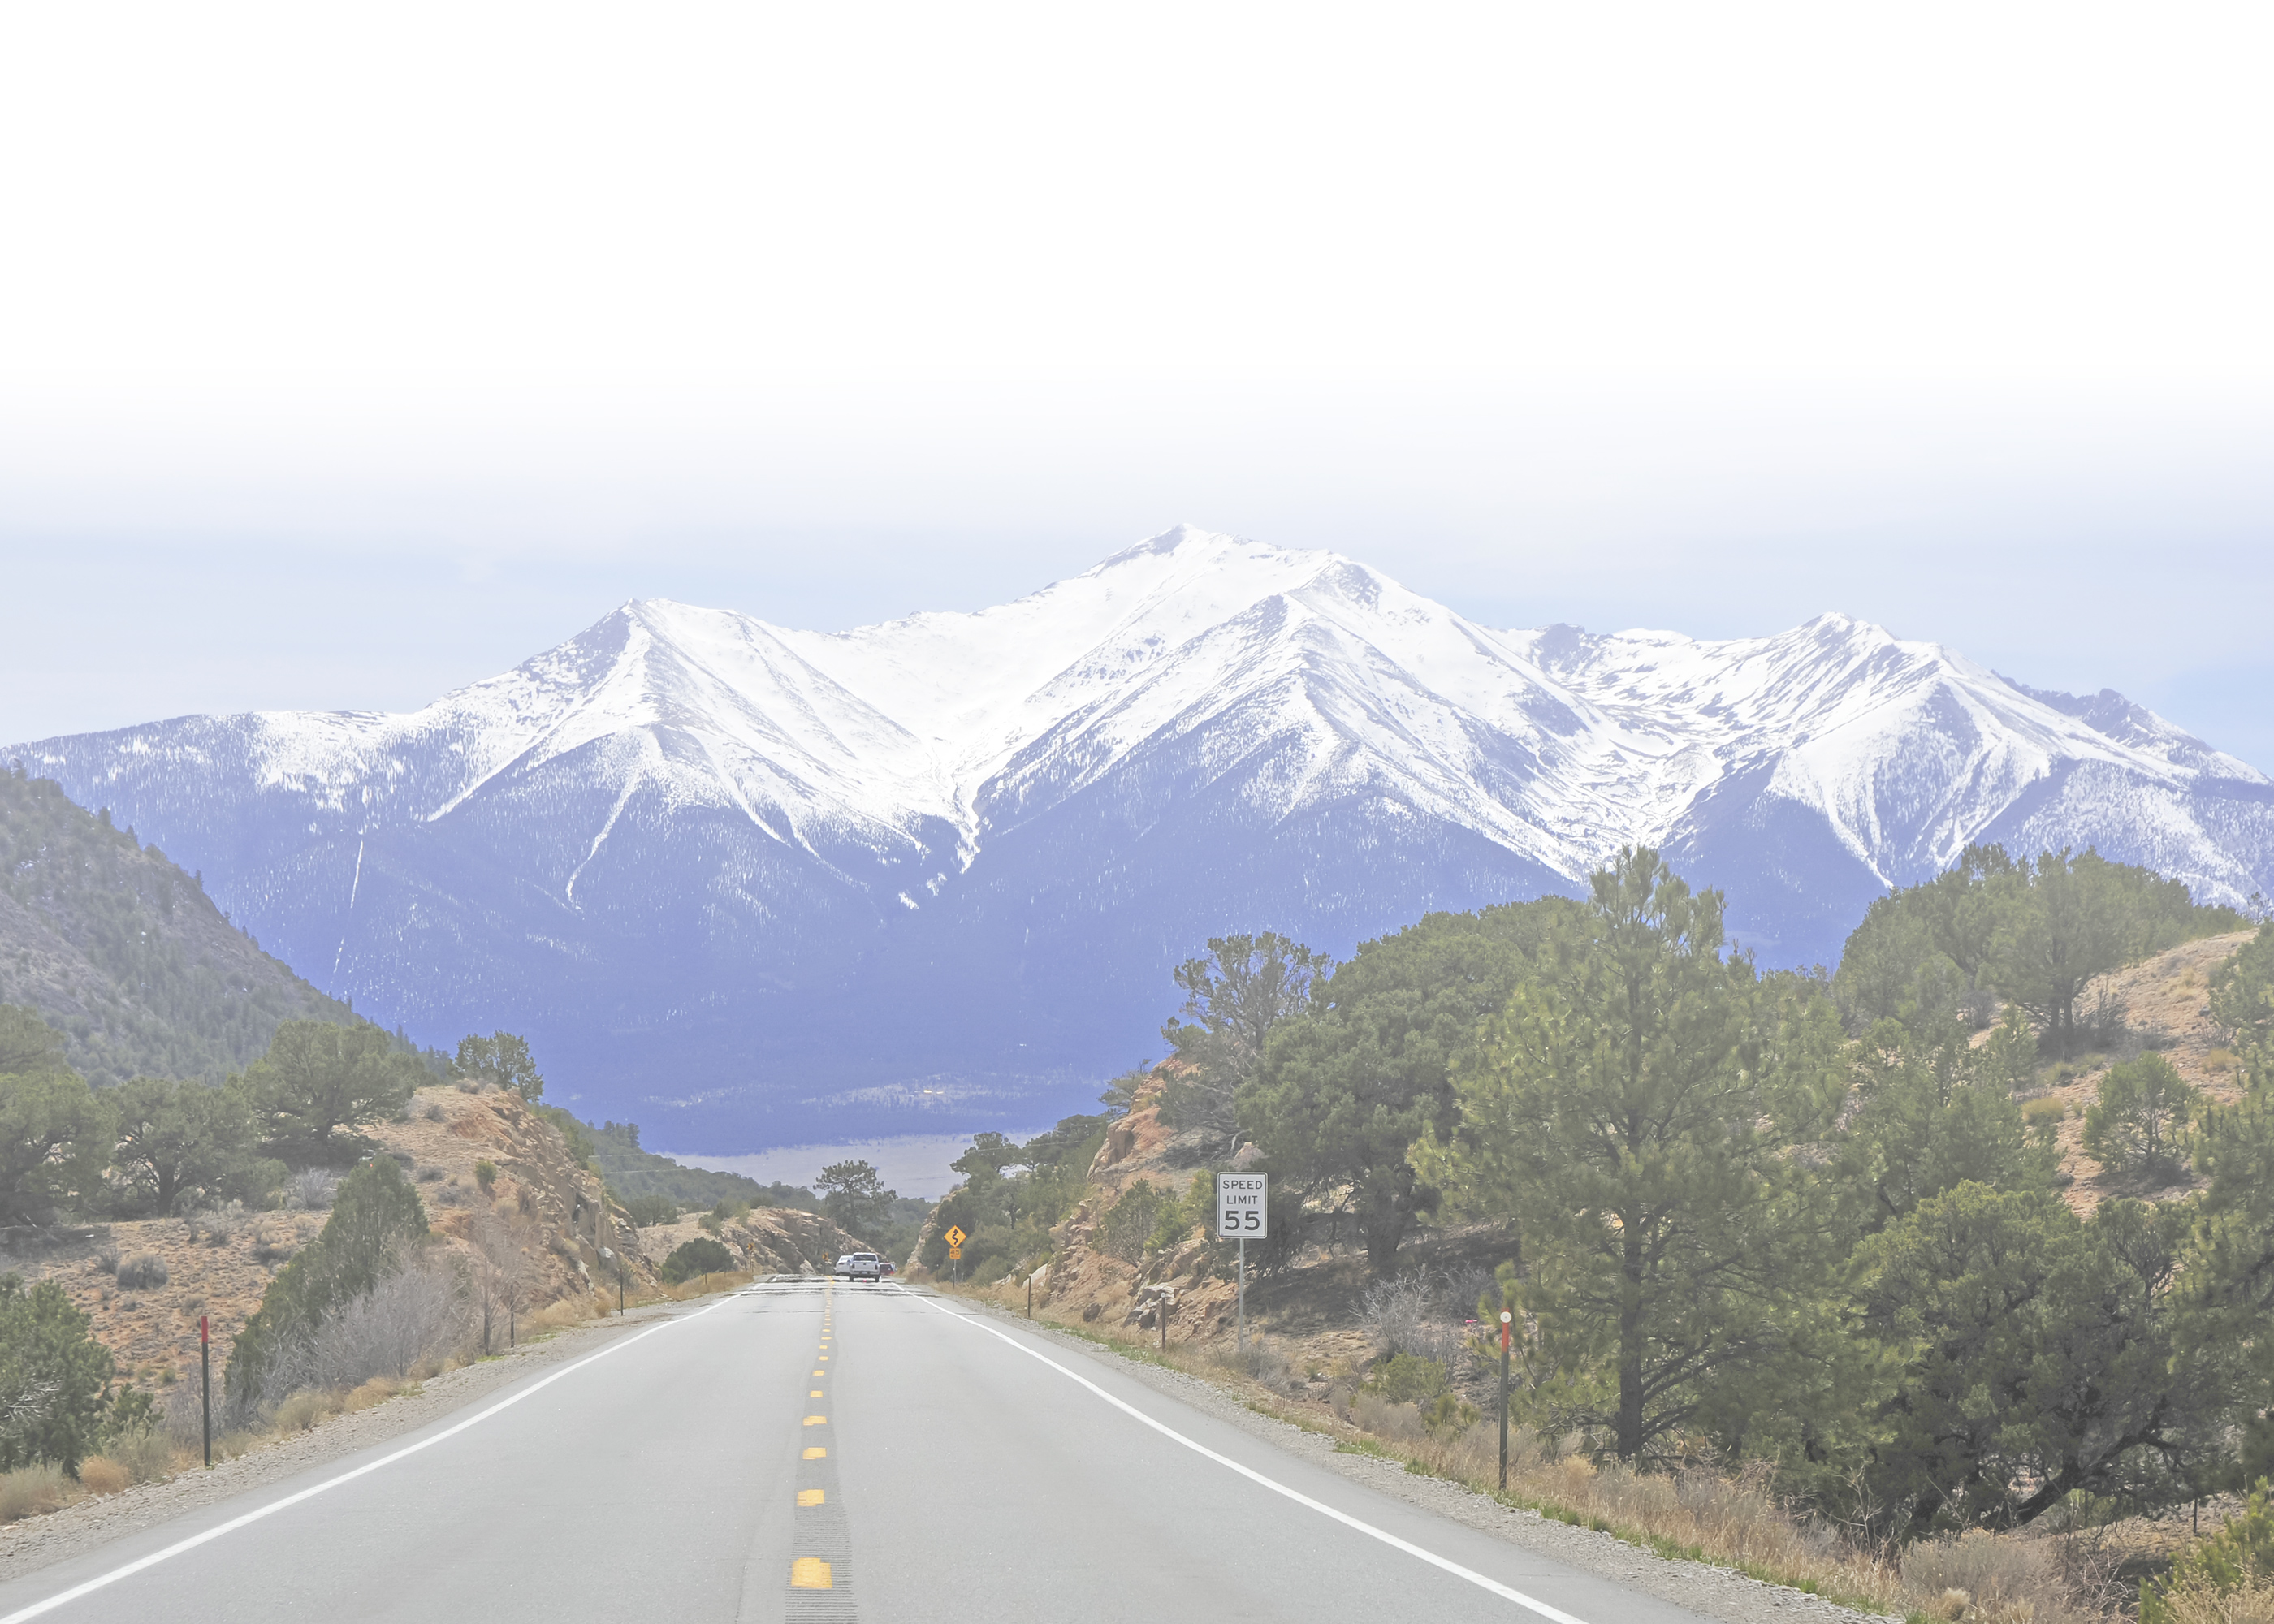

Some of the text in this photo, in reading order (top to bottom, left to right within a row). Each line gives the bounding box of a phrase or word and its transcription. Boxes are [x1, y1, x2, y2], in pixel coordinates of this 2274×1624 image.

[1223, 1180, 1263, 1190] SPEED
[1226, 1195, 1258, 1205] LIMIT
[1225, 1210, 1260, 1231] 55
